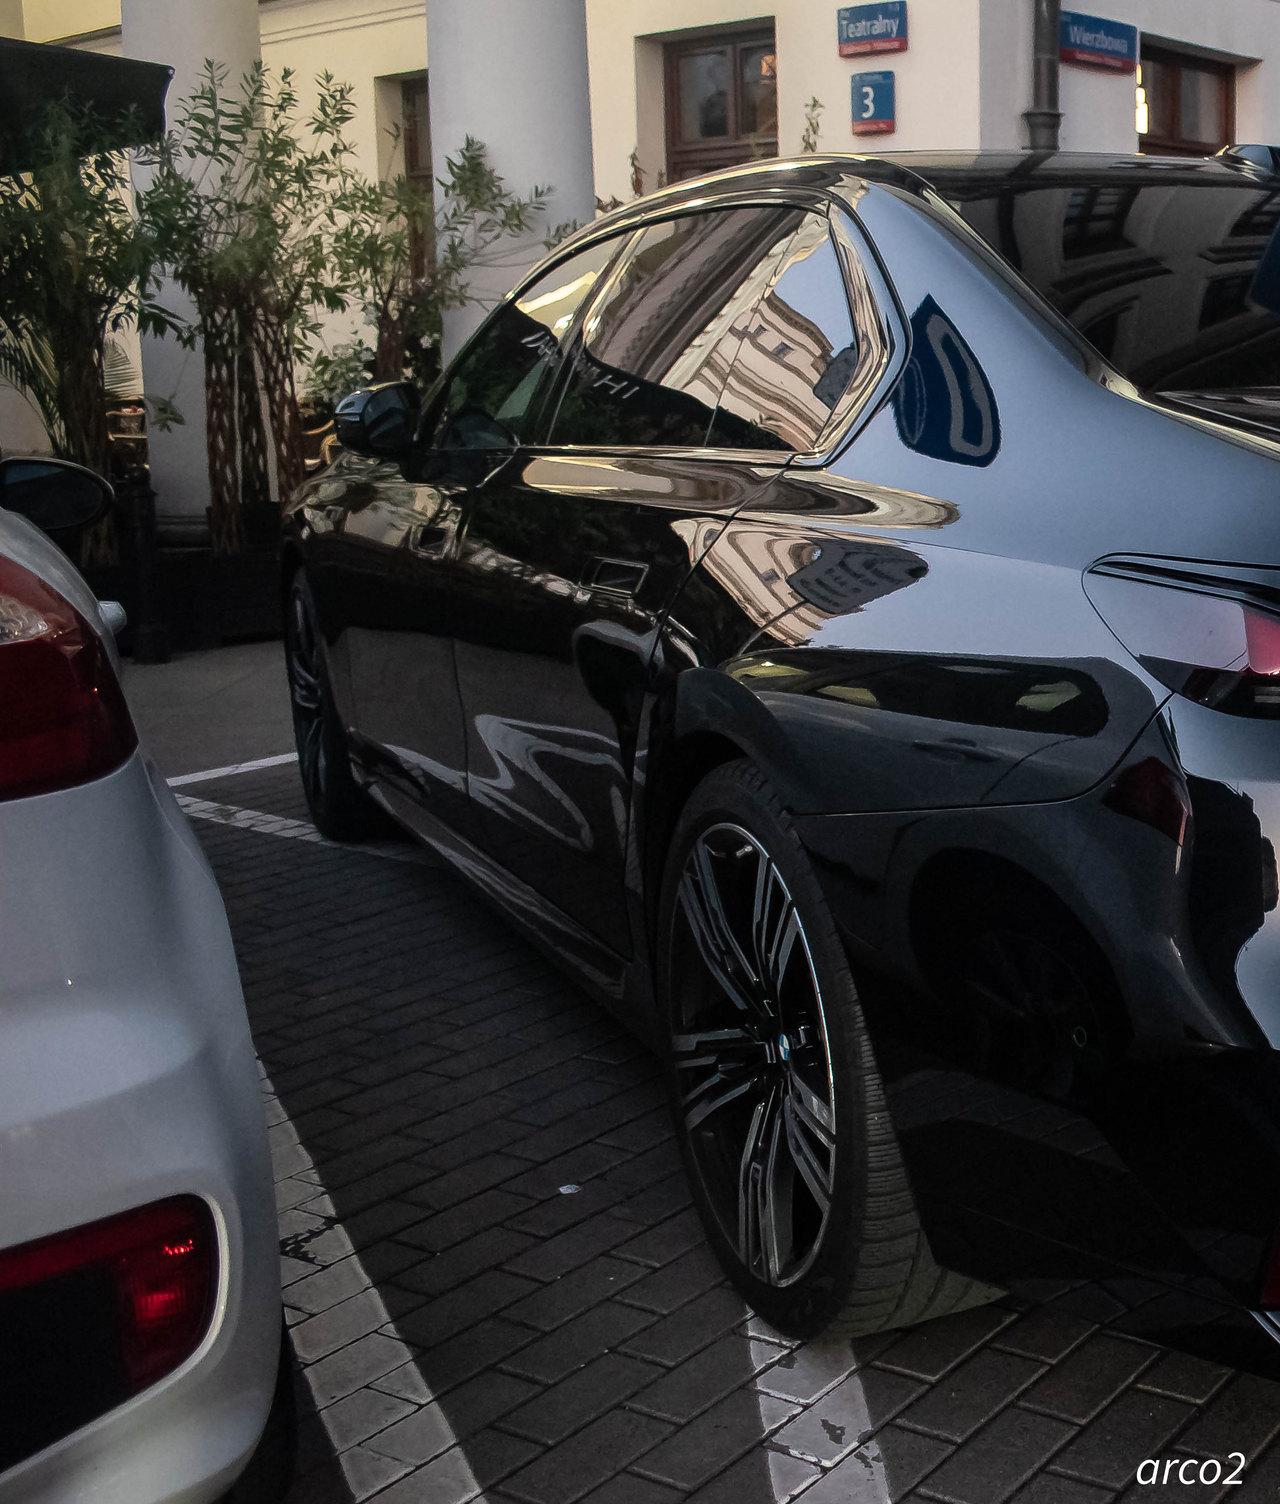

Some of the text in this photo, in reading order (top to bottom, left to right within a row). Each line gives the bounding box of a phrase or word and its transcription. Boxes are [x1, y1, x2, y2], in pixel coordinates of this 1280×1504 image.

[841, 14, 900, 39] Teatralny
[1069, 25, 1128, 53] Wierzbowa
[862, 86, 875, 118] 3
